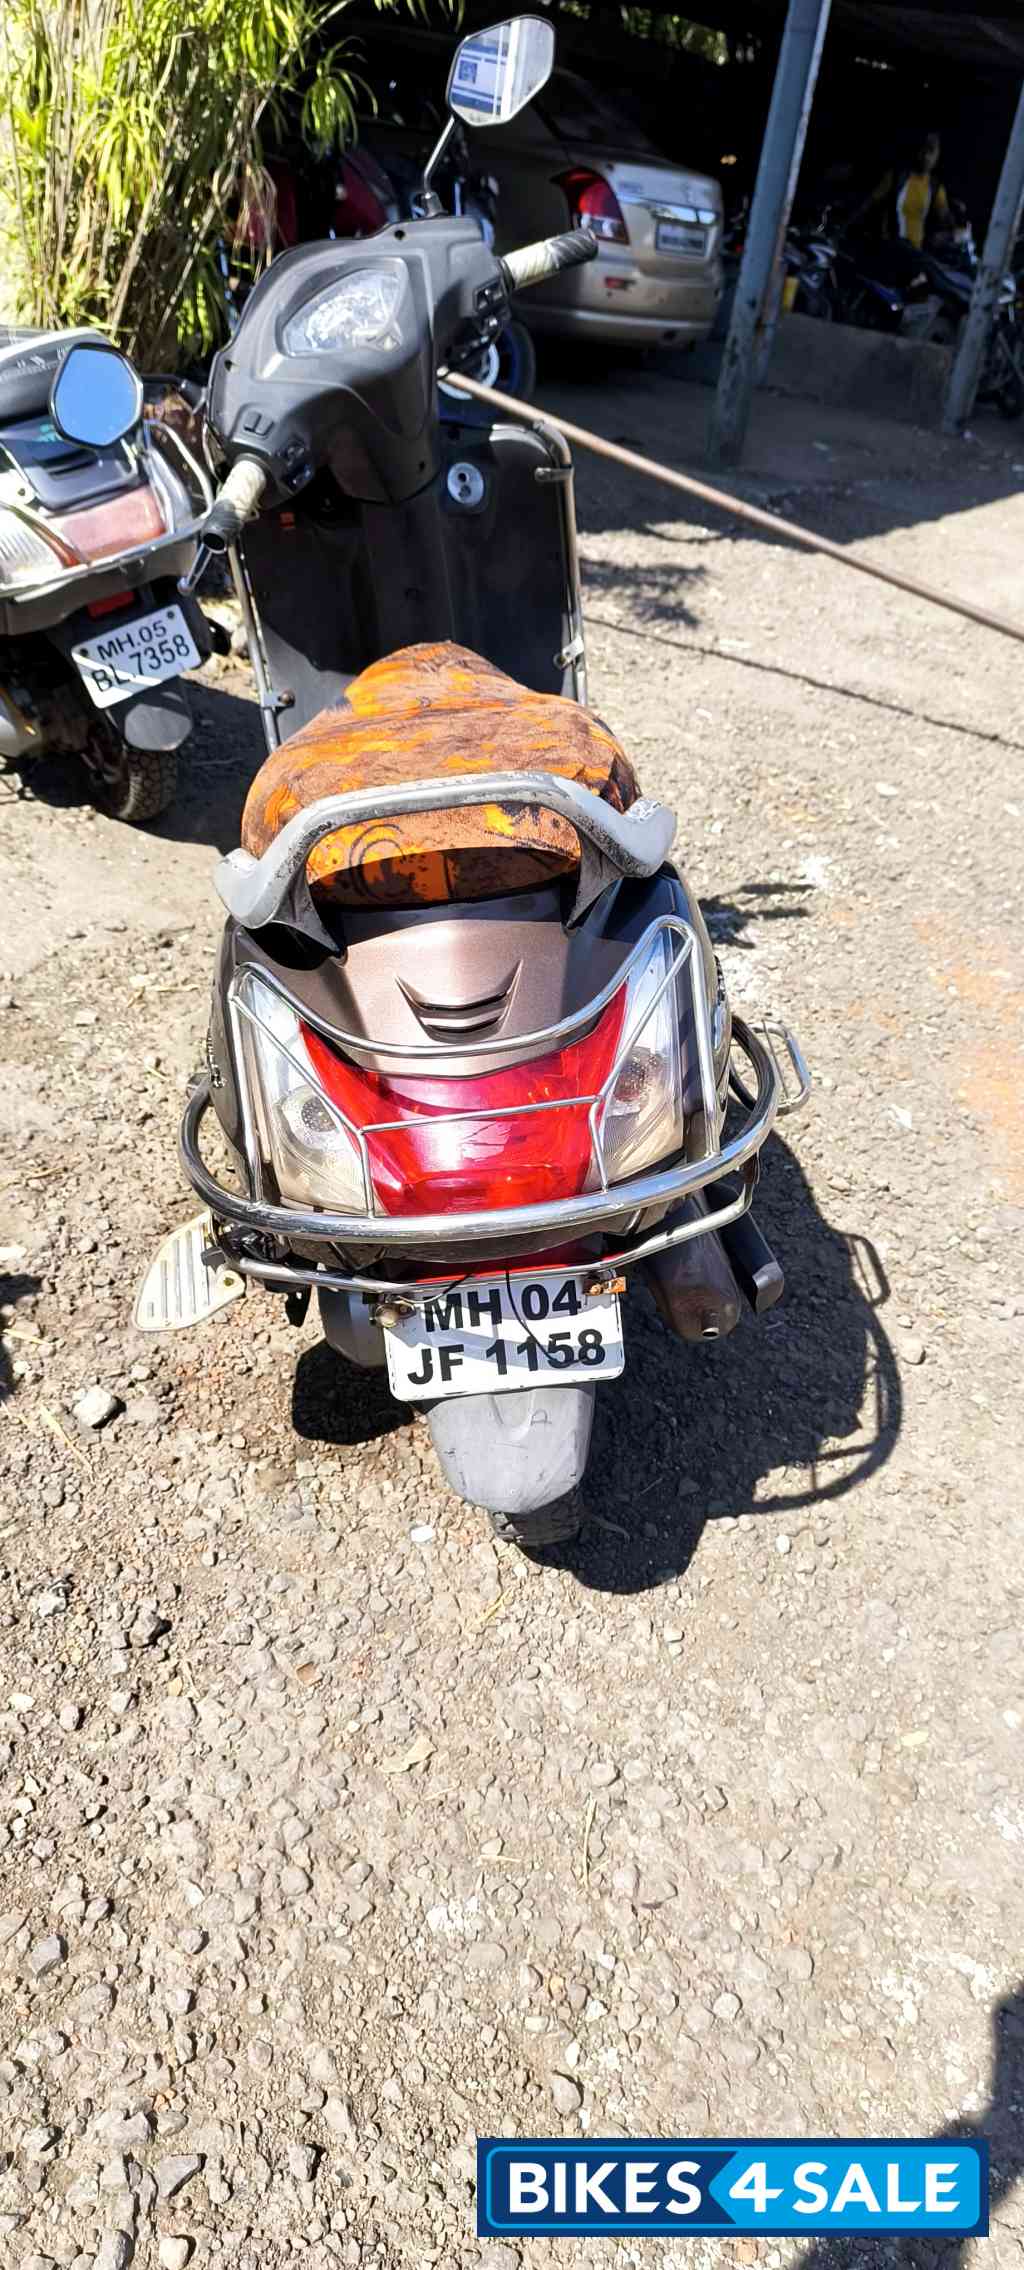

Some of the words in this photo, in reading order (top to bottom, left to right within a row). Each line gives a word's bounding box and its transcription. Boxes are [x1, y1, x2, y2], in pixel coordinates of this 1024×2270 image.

[423, 1288, 502, 1332] MH
[521, 1280, 581, 1321] 04
[408, 1344, 464, 1385] JF
[486, 1329, 606, 1376] 1158
